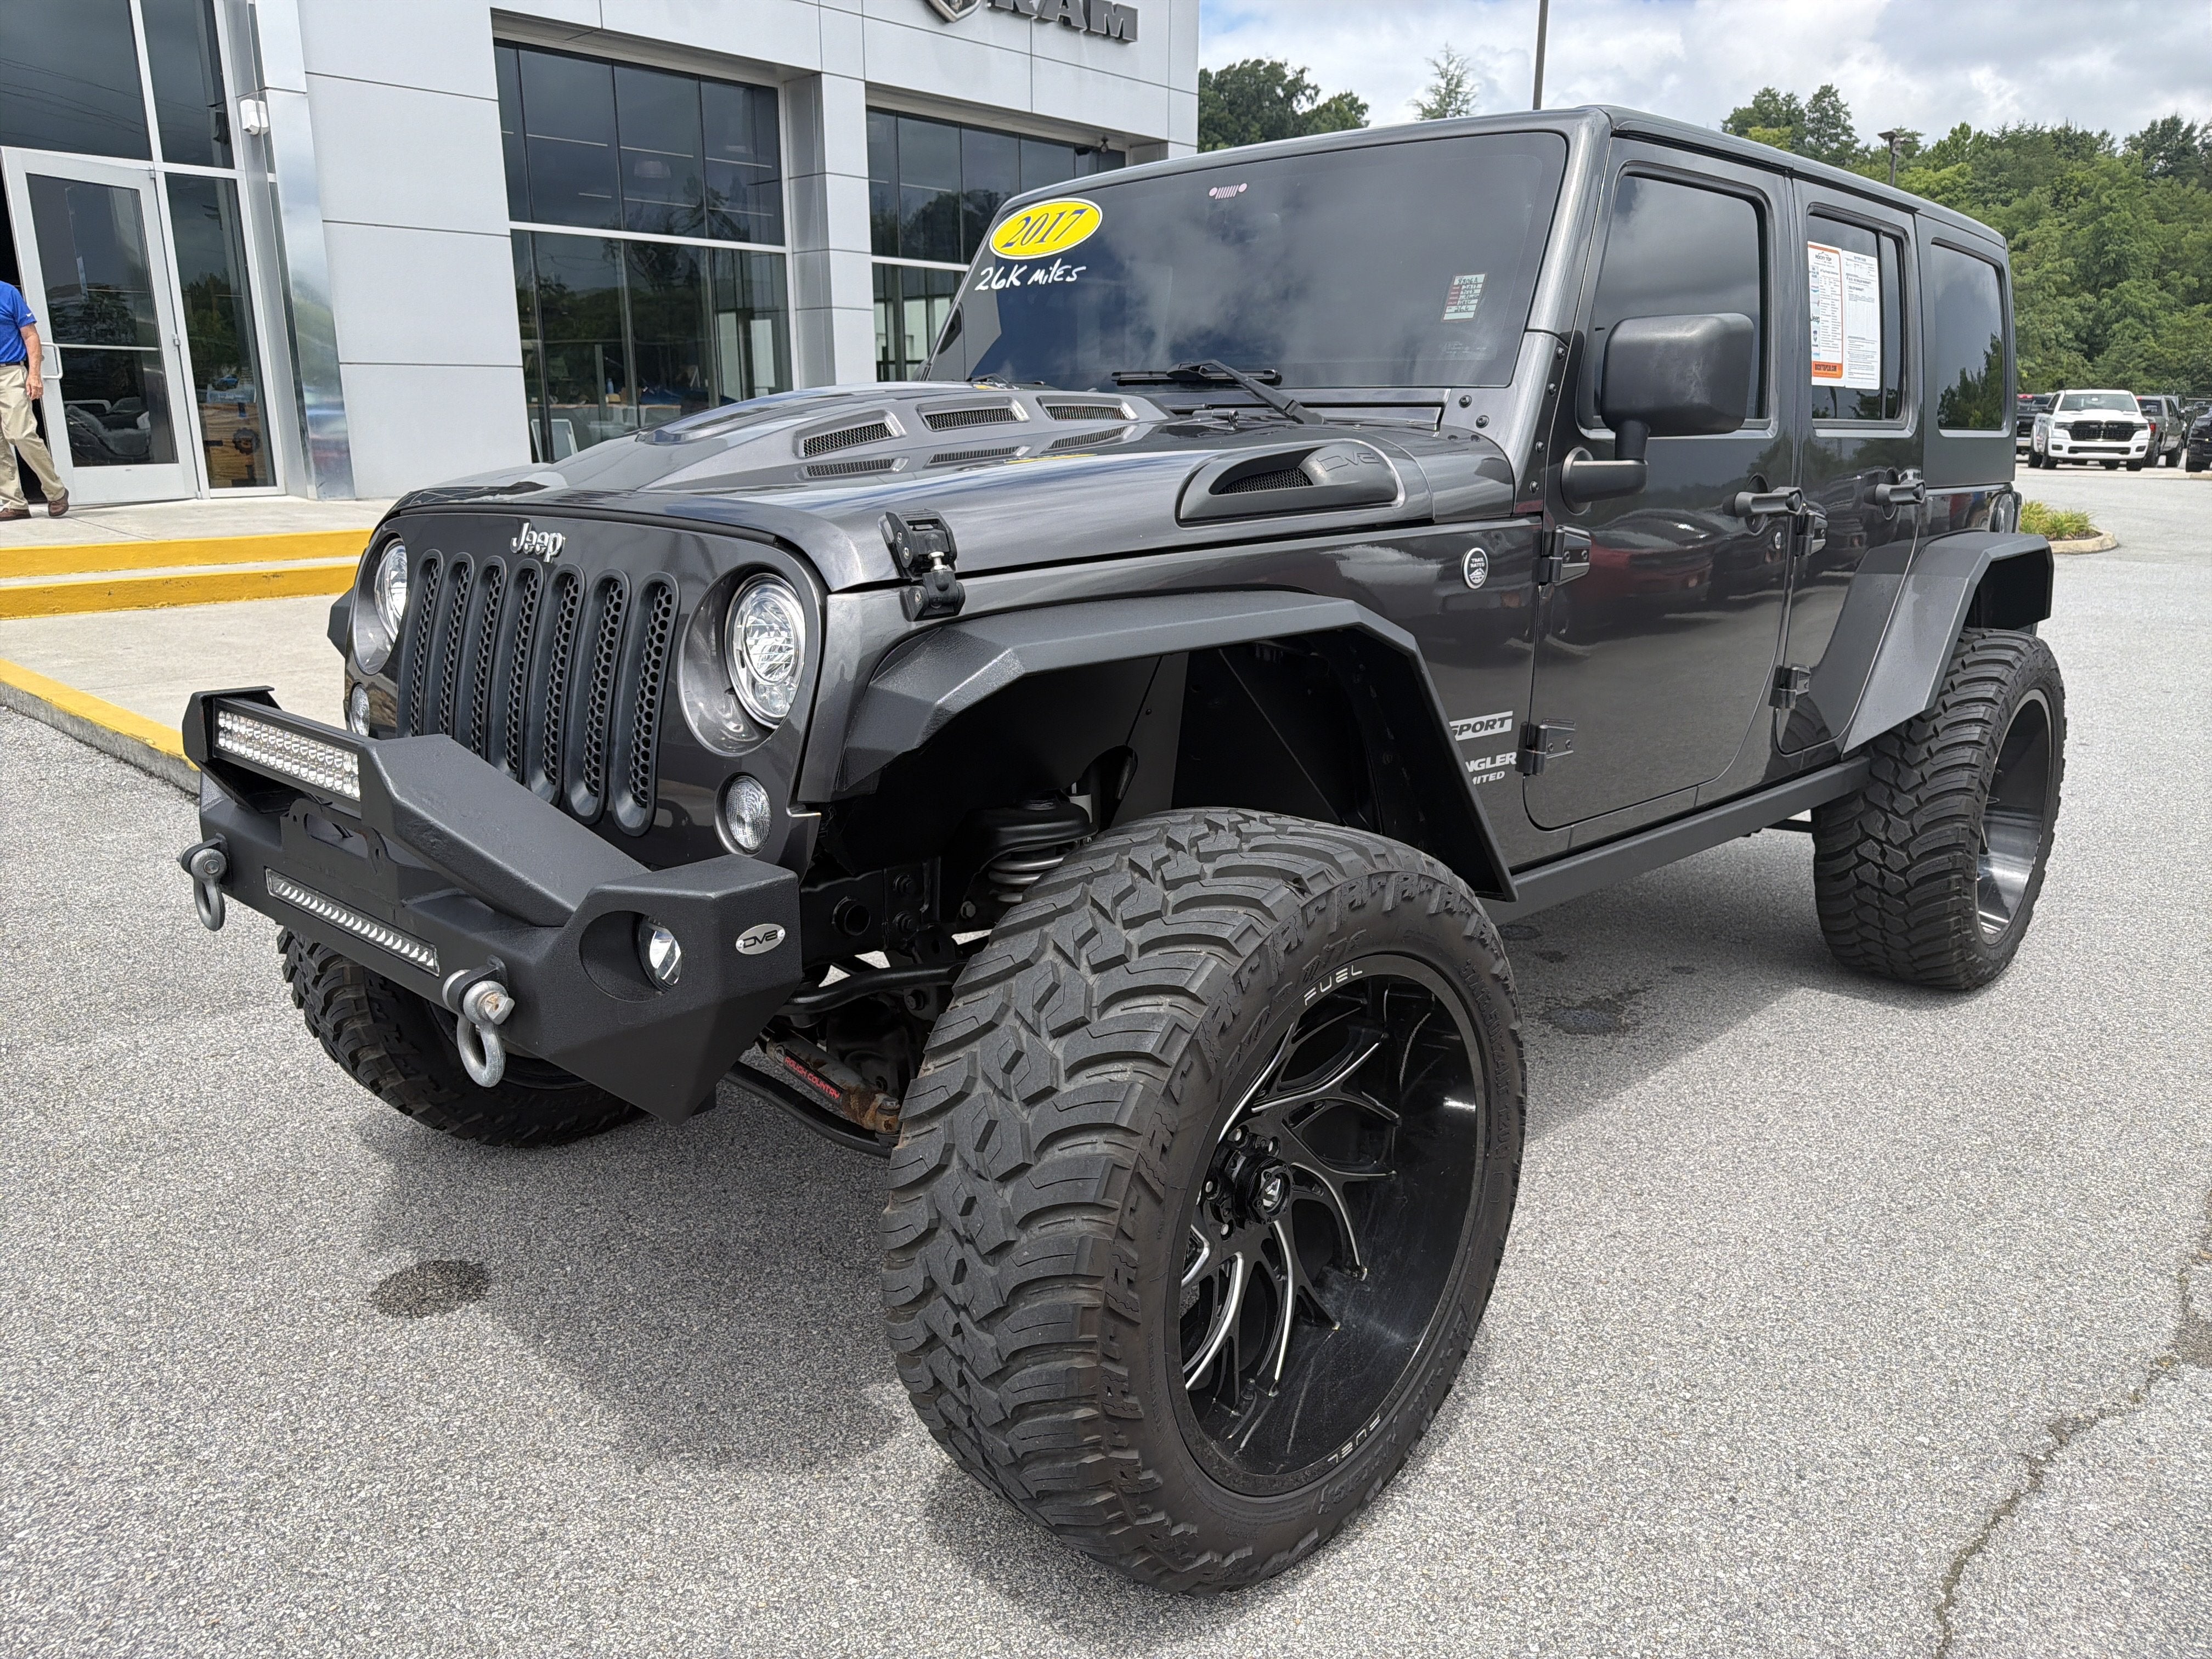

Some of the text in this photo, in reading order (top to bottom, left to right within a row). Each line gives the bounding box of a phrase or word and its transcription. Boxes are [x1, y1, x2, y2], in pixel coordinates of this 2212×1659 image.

[1001, 208, 1089, 249] 2017
[974, 264, 1028, 291] 26K
[510, 522, 566, 563] Jeep
[1451, 716, 1514, 736] SPORT
[1304, 965, 1363, 1006] FUEL
[785, 1057, 840, 1100] ROUGH COUNTRY
[1328, 1413, 1380, 1463] FUEL
